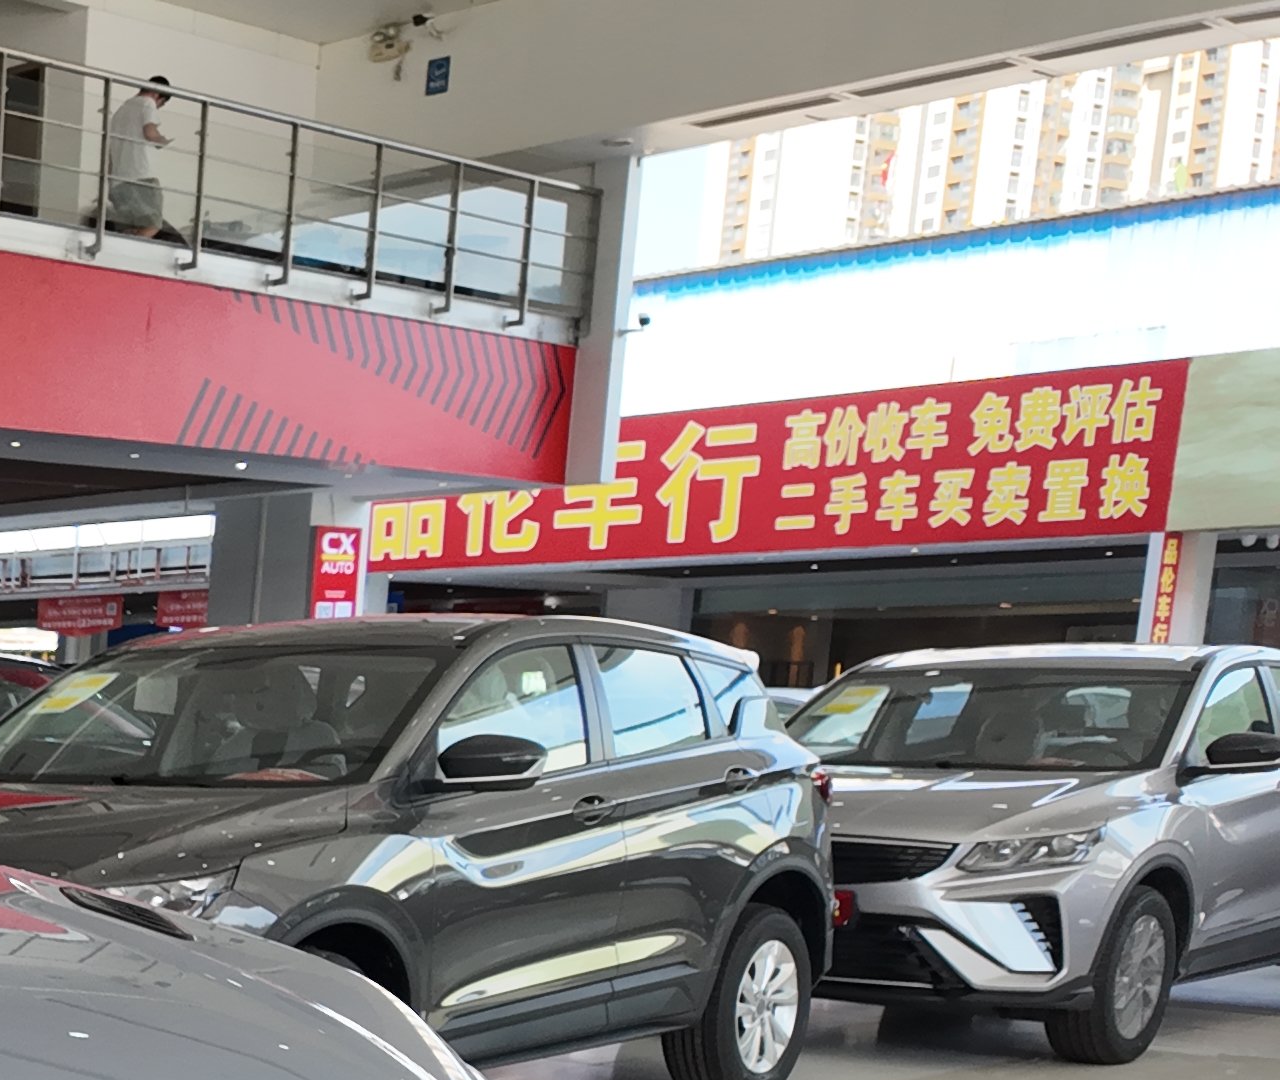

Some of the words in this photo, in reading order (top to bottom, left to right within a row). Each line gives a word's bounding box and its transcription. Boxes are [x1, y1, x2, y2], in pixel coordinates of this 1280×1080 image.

[782, 397, 951, 470] 高价收车
[967, 376, 1162, 456] 免费评估
[774, 453, 1151, 535] 二手车买卖置换
[321, 532, 357, 554] CX
[321, 561, 355, 574] AUTO
